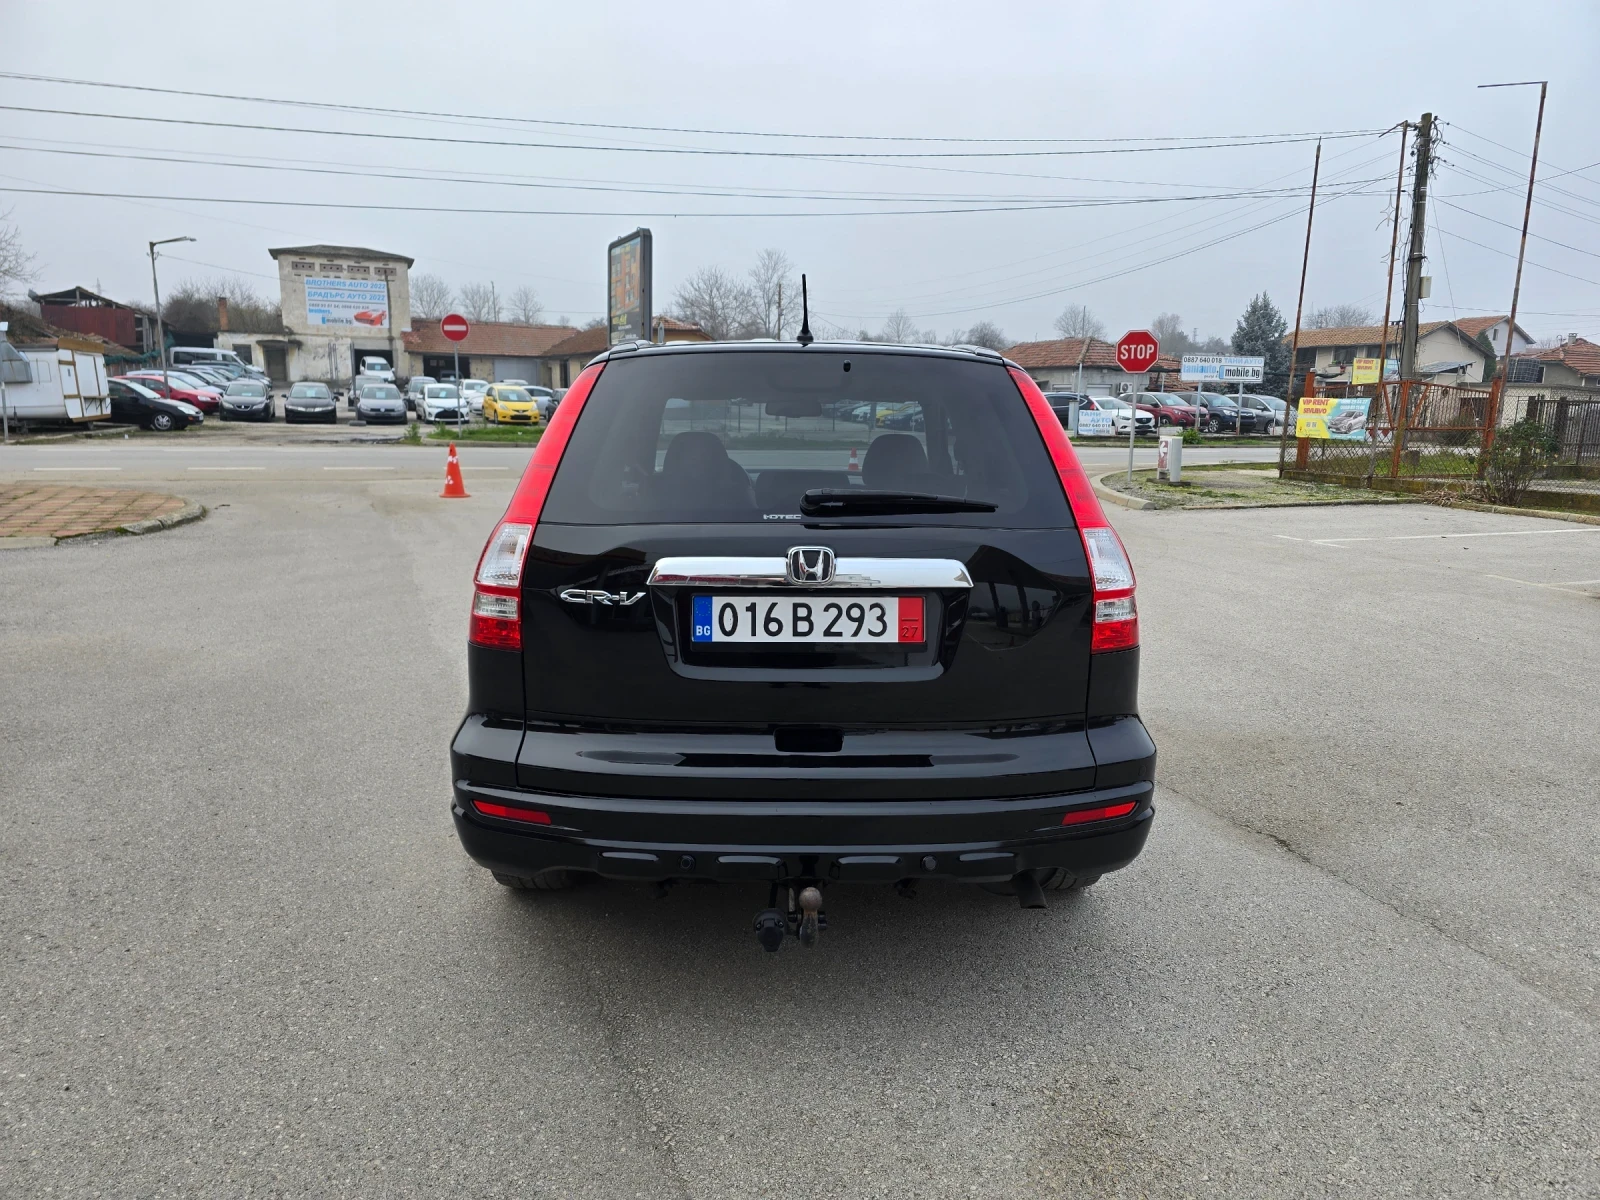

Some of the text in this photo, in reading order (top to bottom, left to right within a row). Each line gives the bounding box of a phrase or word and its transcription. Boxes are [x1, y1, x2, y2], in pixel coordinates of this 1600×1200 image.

[305, 279, 347, 287] BROTHERS
[347, 281, 369, 289] AUTO
[307, 291, 346, 299] БРАДЪРС
[1120, 344, 1155, 360] STOP
[560, 589, 647, 606] CR-V
[695, 625, 711, 636] BG
[901, 625, 918, 638] 27
